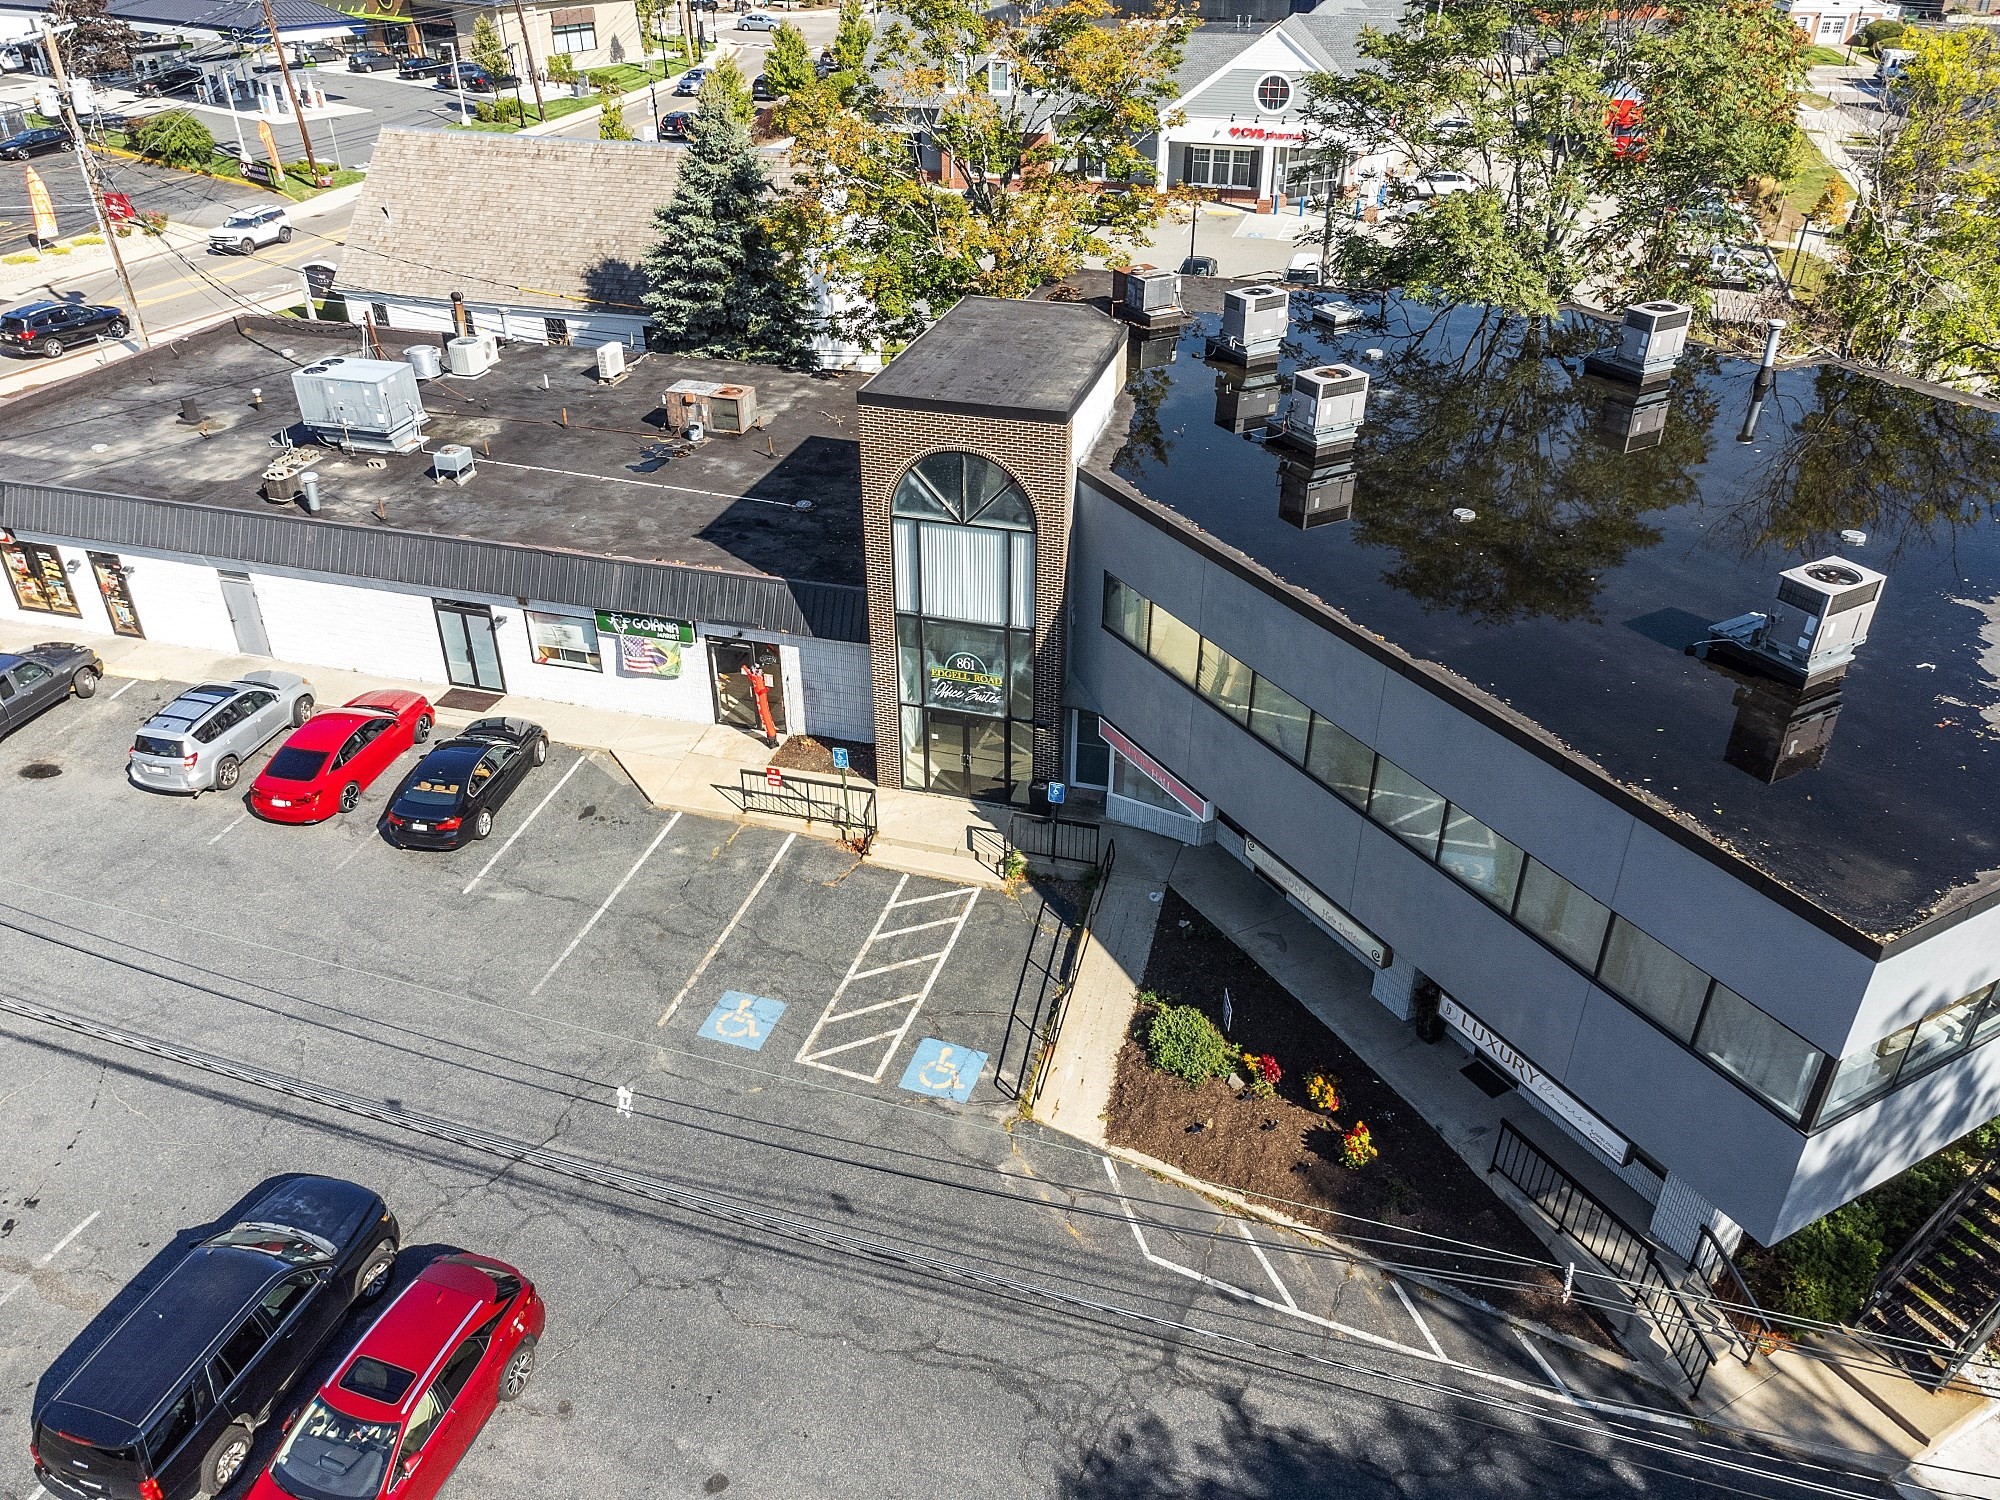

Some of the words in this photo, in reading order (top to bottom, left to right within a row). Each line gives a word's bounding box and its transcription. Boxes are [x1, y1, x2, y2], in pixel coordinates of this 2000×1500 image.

[1241, 127, 1265, 139] CVS
[956, 657, 975, 671] 861
[931, 668, 971, 681] EDGELL
[974, 674, 1003, 685] ROAD
[934, 681, 965, 698] Office
[965, 685, 1002, 704] Suites
[1461, 1013, 1541, 1086] LUXURY
